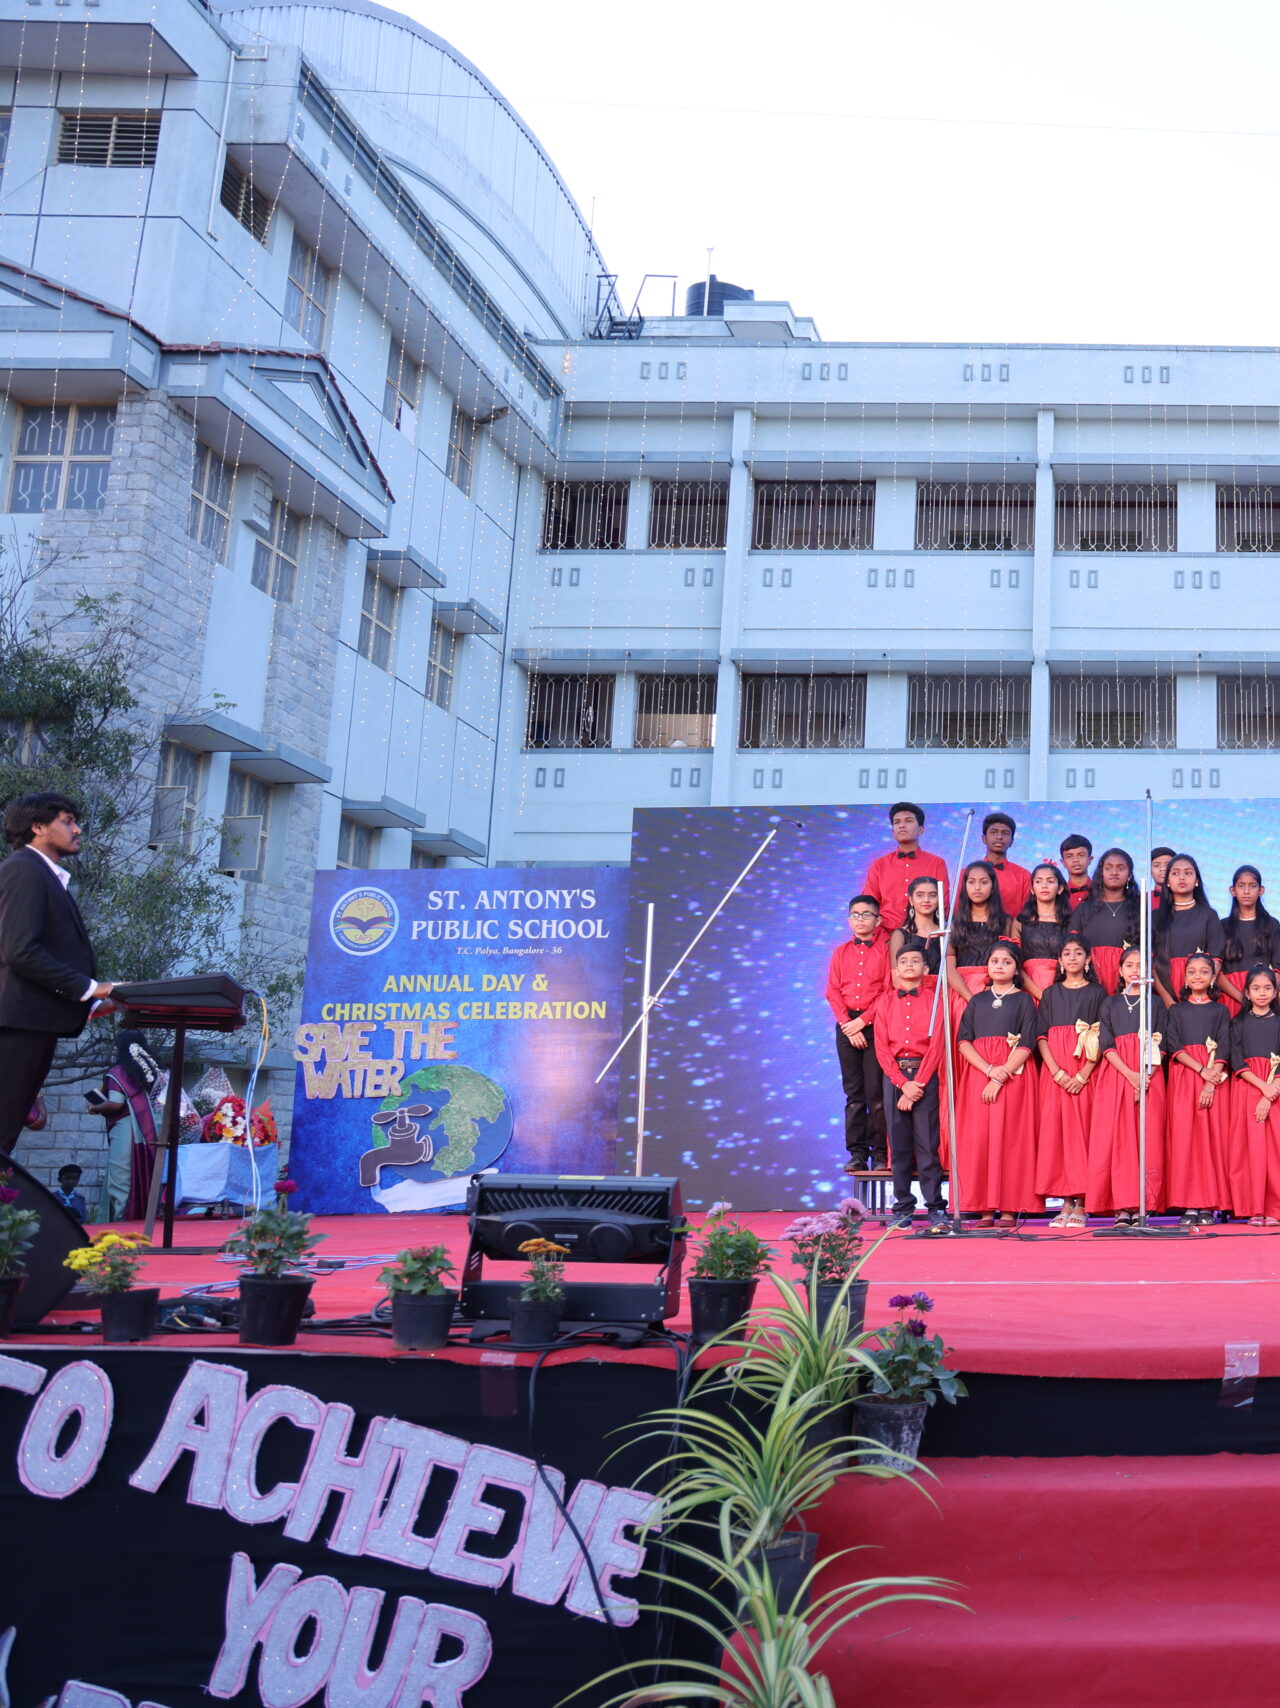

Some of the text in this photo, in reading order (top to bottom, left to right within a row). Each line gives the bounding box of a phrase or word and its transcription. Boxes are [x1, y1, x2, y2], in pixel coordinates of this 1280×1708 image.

[427, 888, 597, 910] ST. ANTONY'S
[411, 919, 610, 940] PUBLIC SCHOOL
[456, 947, 473, 955] T.C.
[474, 947, 500, 956] Palya,
[502, 946, 544, 956] Bangalore
[551, 946, 563, 955] 36
[382, 973, 548, 993] ANNUAL DAY &
[321, 1001, 607, 1022] CHRISTMAS CELEBRATION
[294, 1021, 460, 1062] SAVE THE
[302, 1059, 405, 1100] WATER
[128, 1359, 669, 1627] ACHIEVE
[205, 1551, 493, 1708] YOUR
